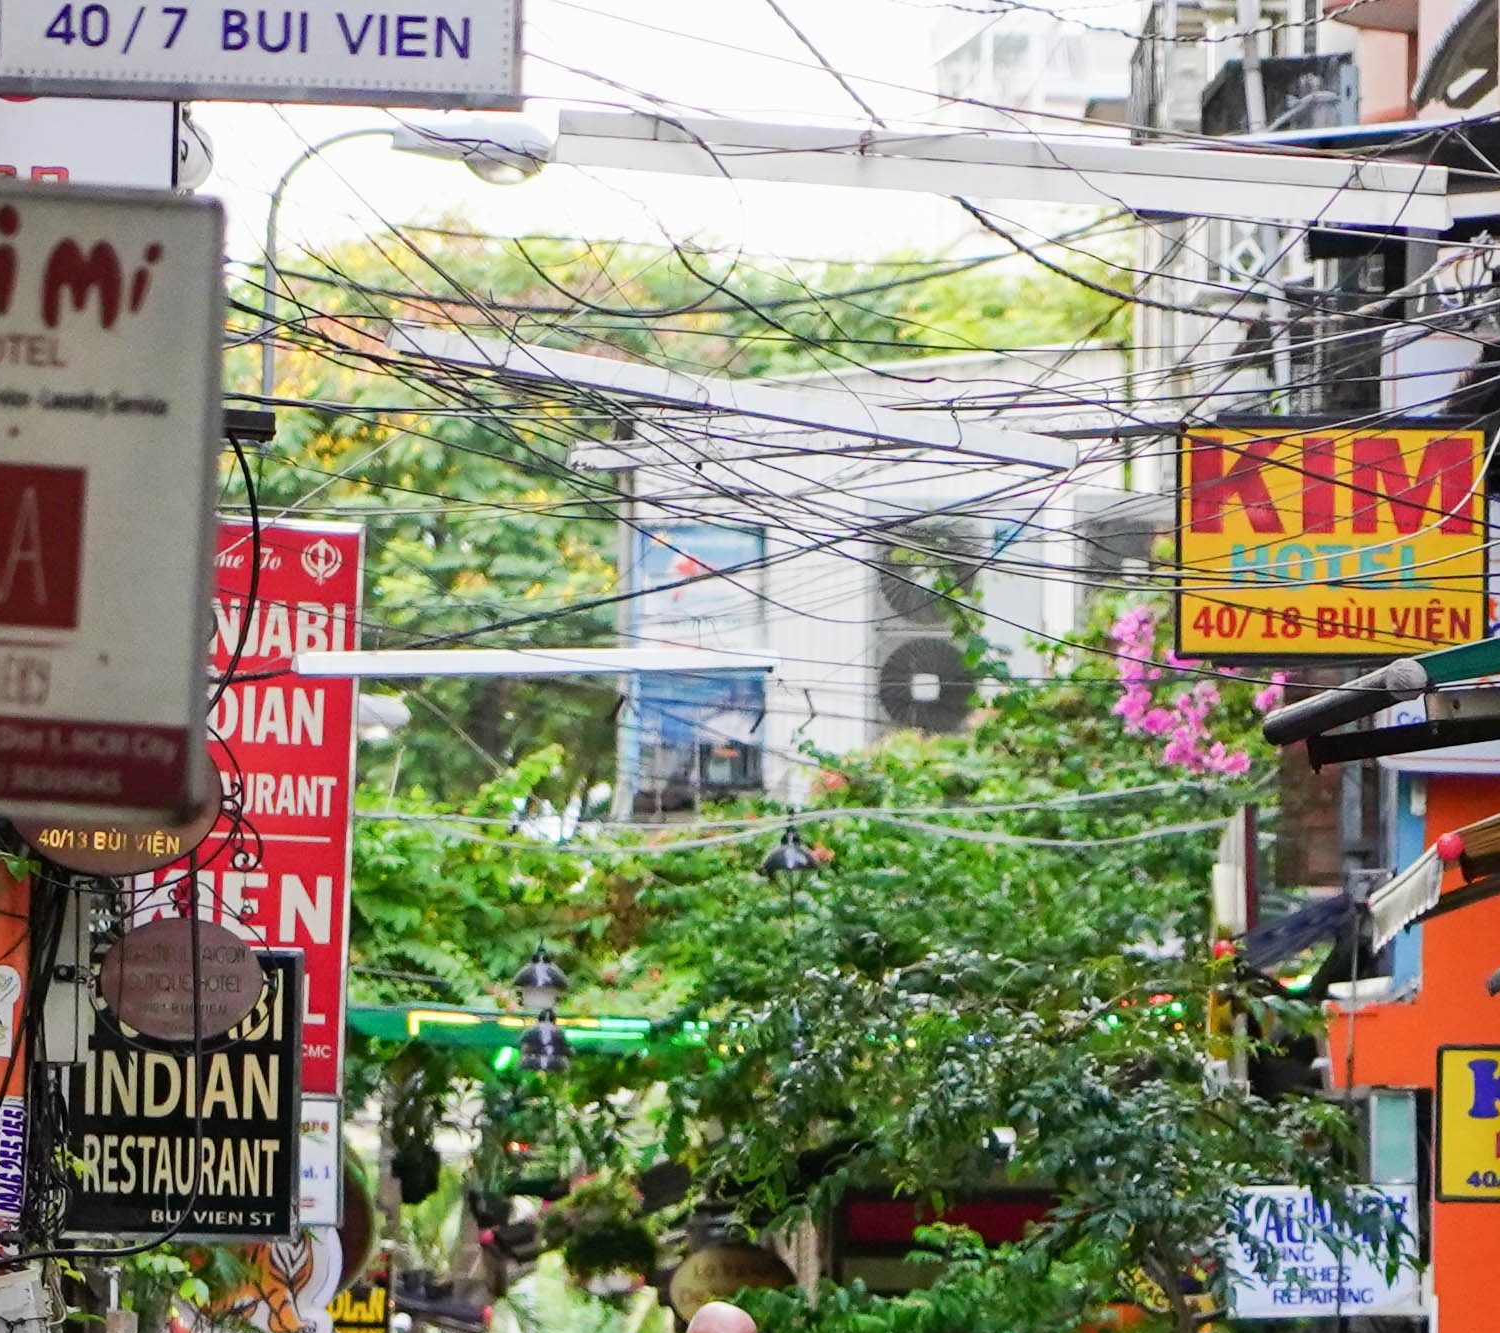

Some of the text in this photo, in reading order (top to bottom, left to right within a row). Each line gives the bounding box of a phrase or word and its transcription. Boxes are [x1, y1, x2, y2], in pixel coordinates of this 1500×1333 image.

[44, 4, 471, 59] 40/7 BUI VIEN
[1190, 436, 1474, 535] KIM
[1230, 543, 1434, 592] HOTEL
[1316, 597, 1376, 641] BÙI
[93, 827, 128, 851] BÙI
[84, 1050, 281, 1120] INDIAN
[82, 1133, 281, 1198] RESTAURANT
[193, 1210, 245, 1226] VIEN
[249, 1211, 276, 1227] ST
